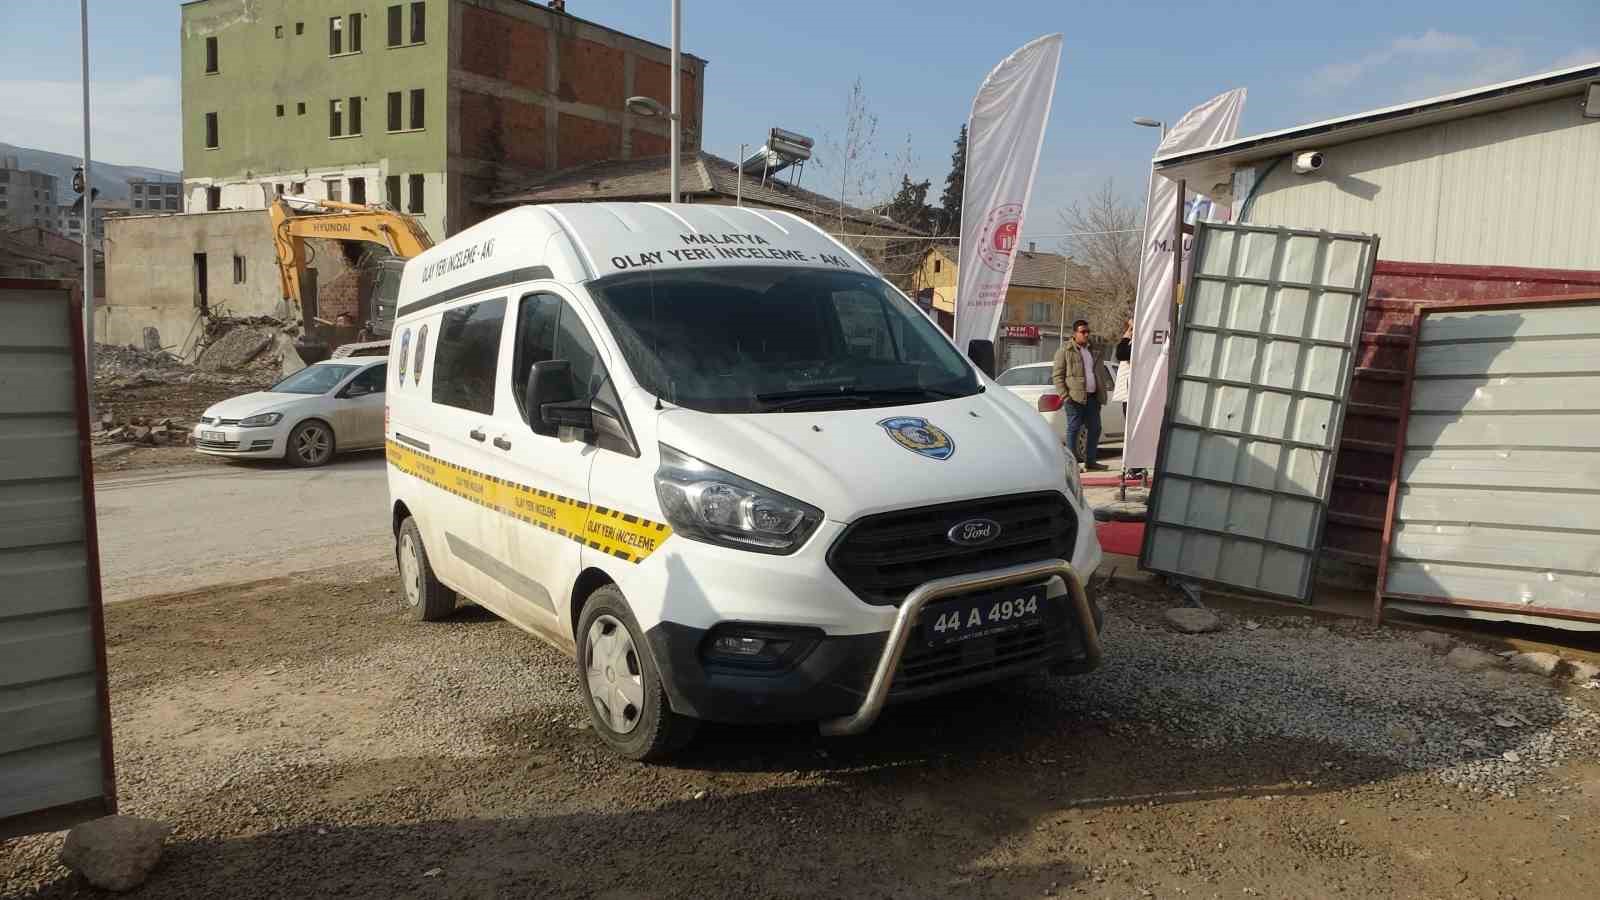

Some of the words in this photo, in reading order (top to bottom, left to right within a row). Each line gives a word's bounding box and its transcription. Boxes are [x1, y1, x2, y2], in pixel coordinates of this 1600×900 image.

[313, 223, 352, 232] HYUNDAI
[680, 233, 770, 245] MALATYA
[611, 250, 664, 270] OLAY
[713, 245, 808, 261] İNCELEME
[587, 520, 602, 534] OLAY
[963, 523, 991, 539] Ford
[934, 610, 961, 633] 44
[966, 607, 982, 629] A
[988, 595, 1038, 622] 4934
